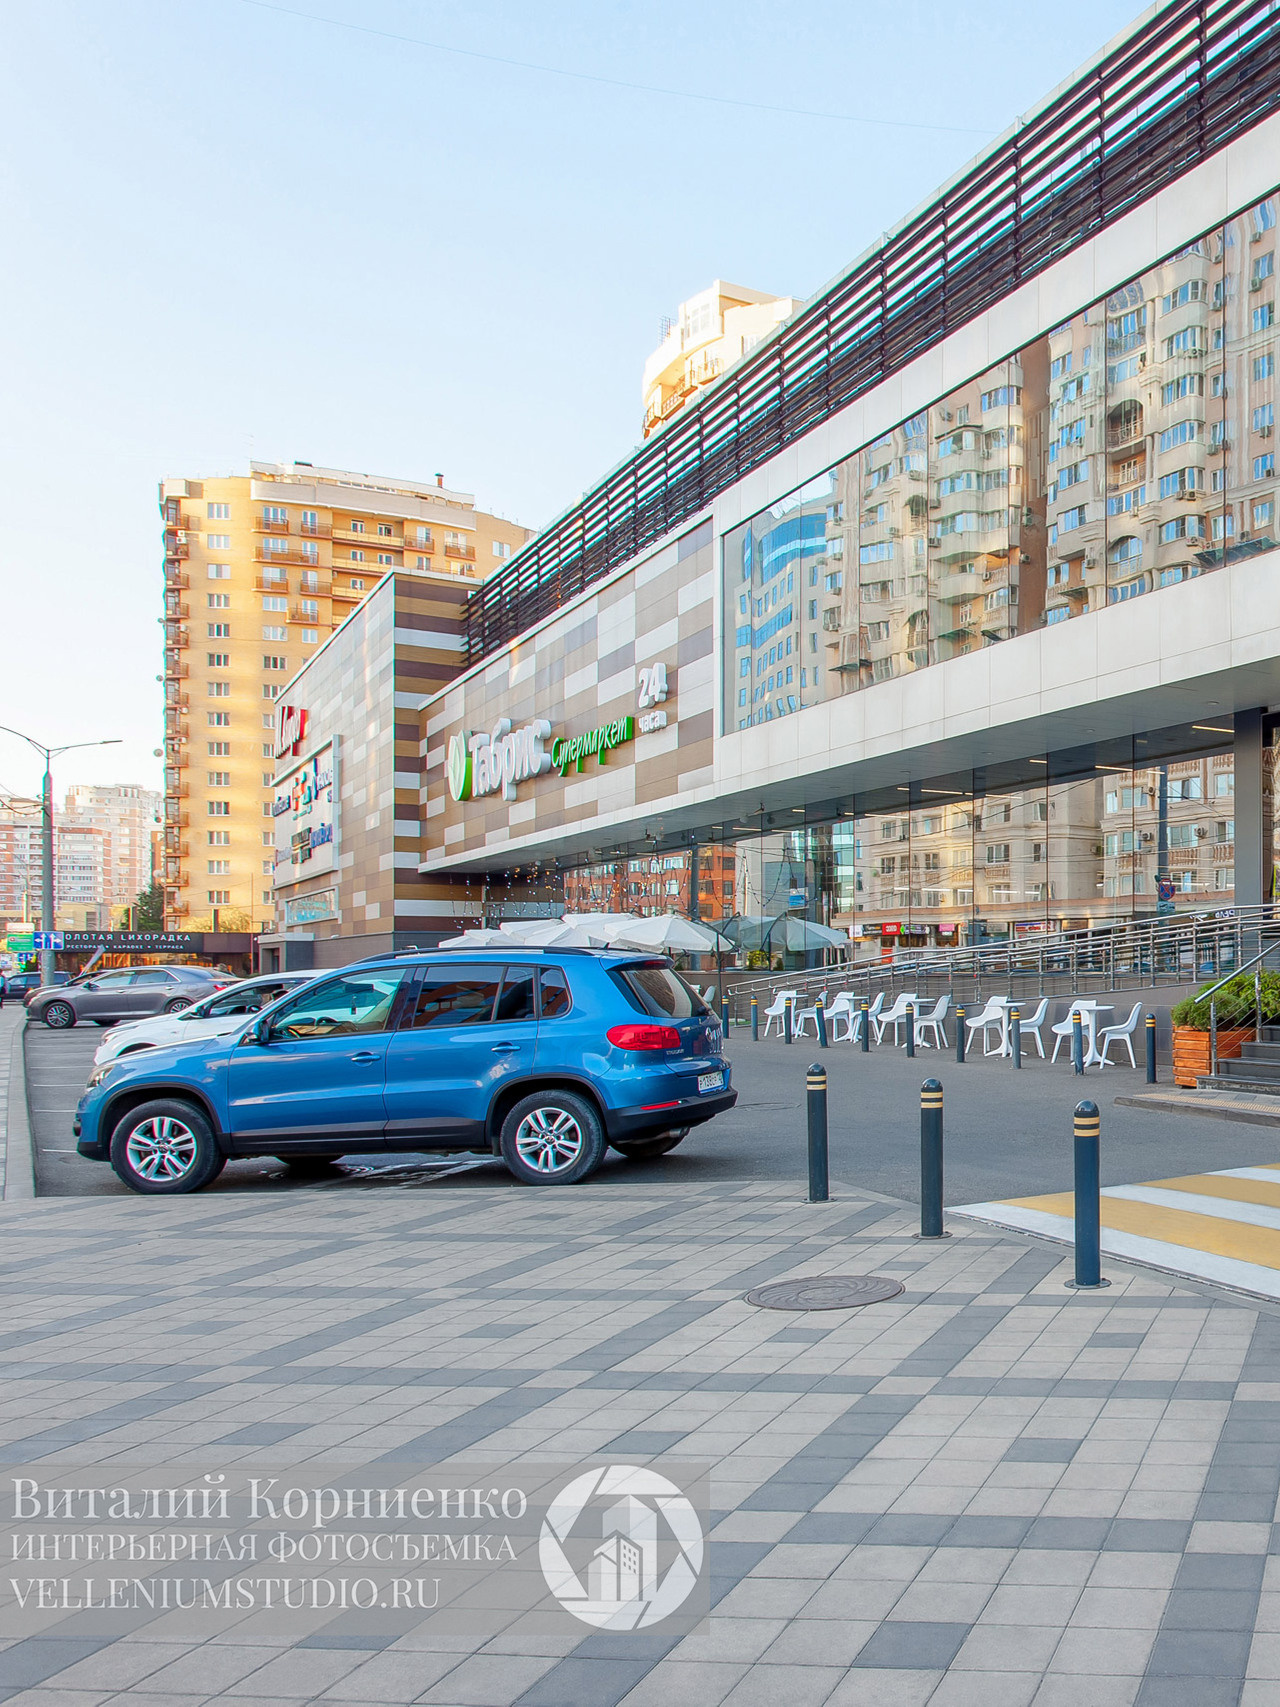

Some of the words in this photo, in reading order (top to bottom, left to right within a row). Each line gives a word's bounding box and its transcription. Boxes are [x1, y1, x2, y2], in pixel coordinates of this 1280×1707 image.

[638, 663, 668, 708] 24
[638, 711, 667, 733] часа
[469, 718, 551, 800] Табрис
[551, 716, 634, 777] Супермаркет
[65, 932, 114, 941] ОЛОТАЯ
